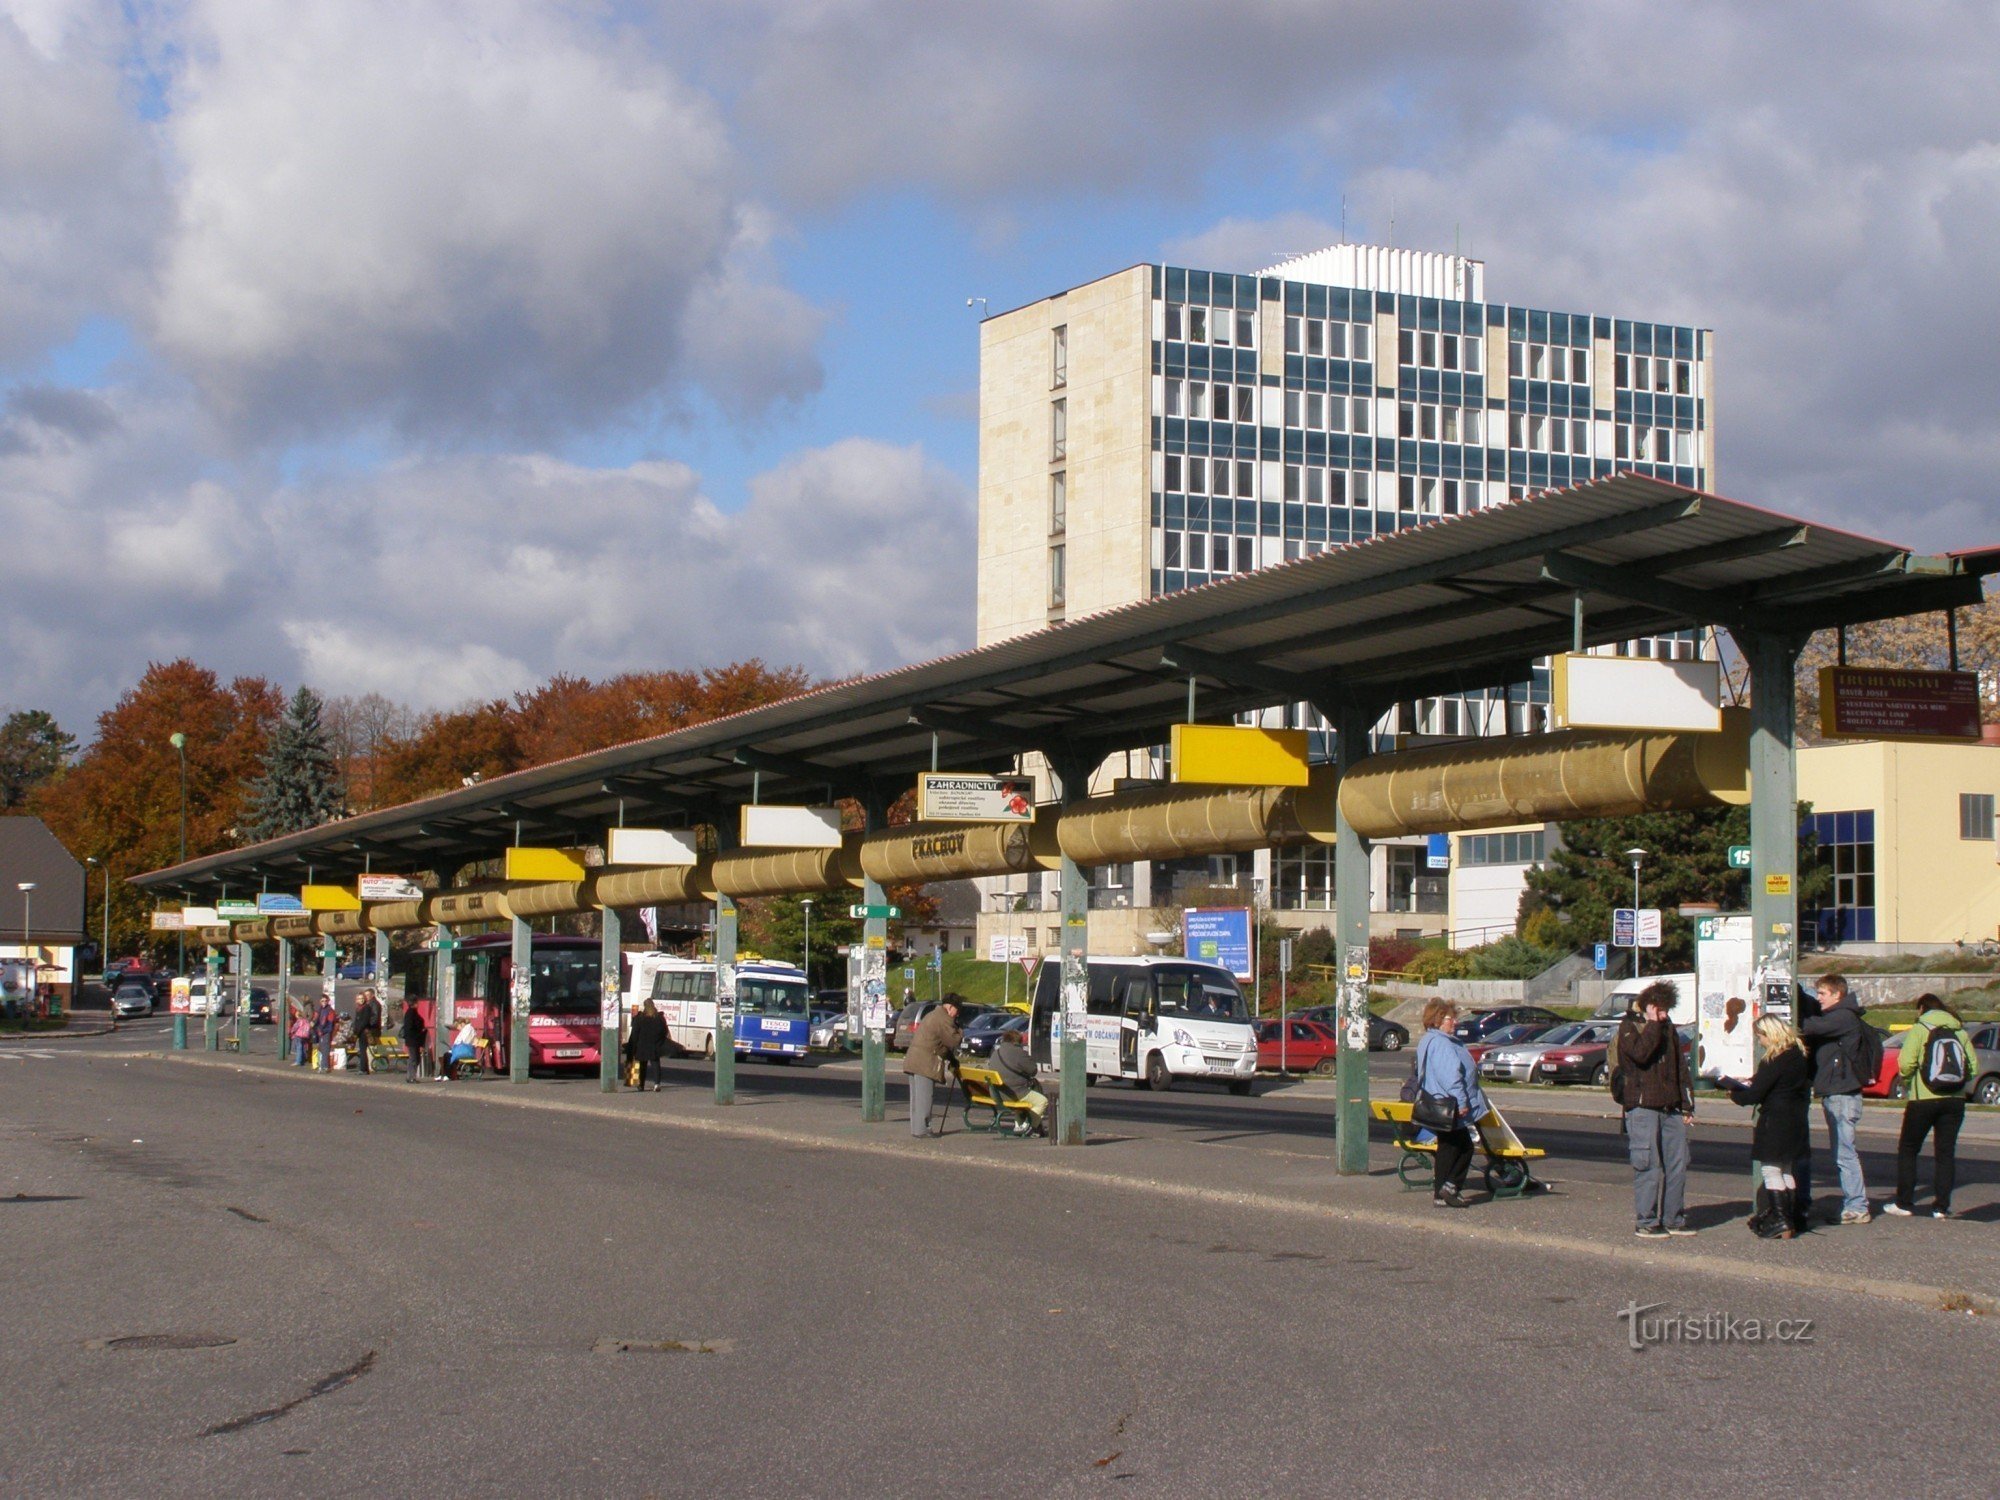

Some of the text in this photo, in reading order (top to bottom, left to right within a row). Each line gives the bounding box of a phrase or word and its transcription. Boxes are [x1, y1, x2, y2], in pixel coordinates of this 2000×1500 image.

[929, 781, 998, 790] ZAHRADNICTVÍ
[1733, 849, 1751, 865] 15
[857, 907, 897, 917] 14 8
[1698, 920, 1713, 938] 15
[764, 1020, 789, 1028] TESCO
